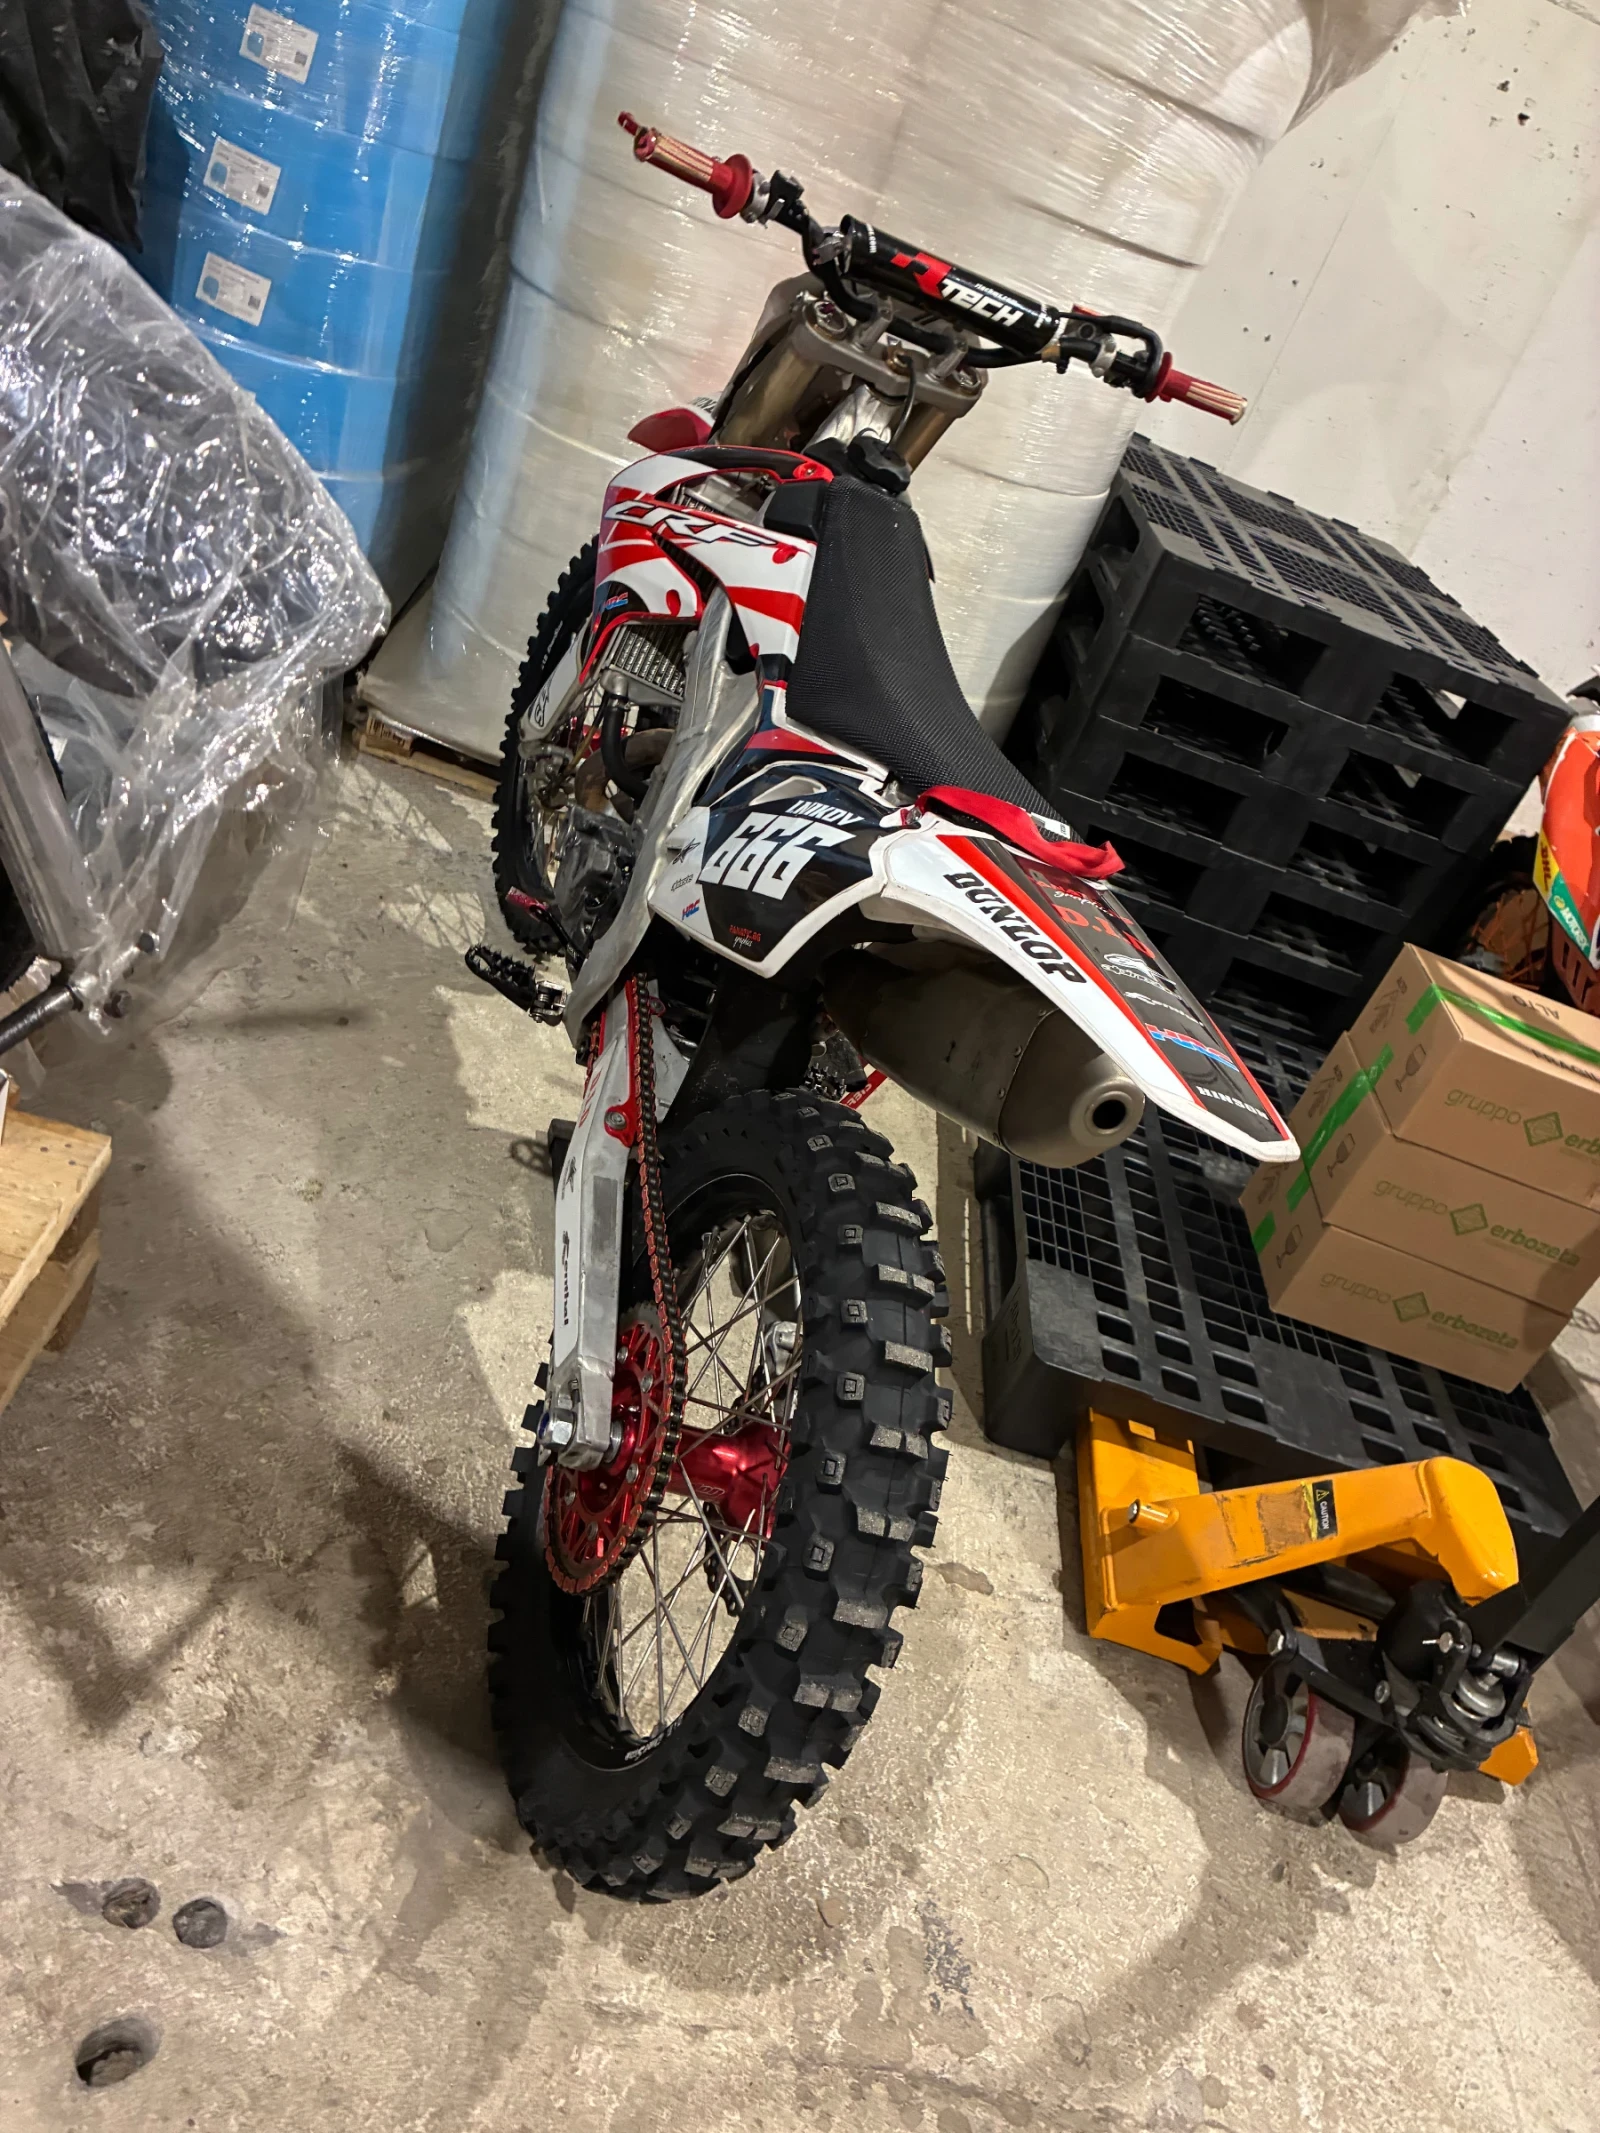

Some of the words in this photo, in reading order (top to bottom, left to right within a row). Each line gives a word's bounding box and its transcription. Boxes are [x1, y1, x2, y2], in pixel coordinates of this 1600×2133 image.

[941, 278, 1024, 327] TECH
[604, 499, 778, 547] CRF
[699, 811, 857, 901] 666
[943, 871, 1087, 984] DUNLOP
[1513, 995, 1560, 1020] ALTO
[1196, 1085, 1270, 1121] HINSON
[1444, 1088, 1522, 1125] gruppo
[1373, 1179, 1449, 1216] gruppo
[1489, 1224, 1581, 1268] erbozeta
[1320, 1272, 1392, 1304] gruppo
[1431, 1310, 1520, 1350] erbozeta
[1320, 1500, 1330, 1530] CAUTION
